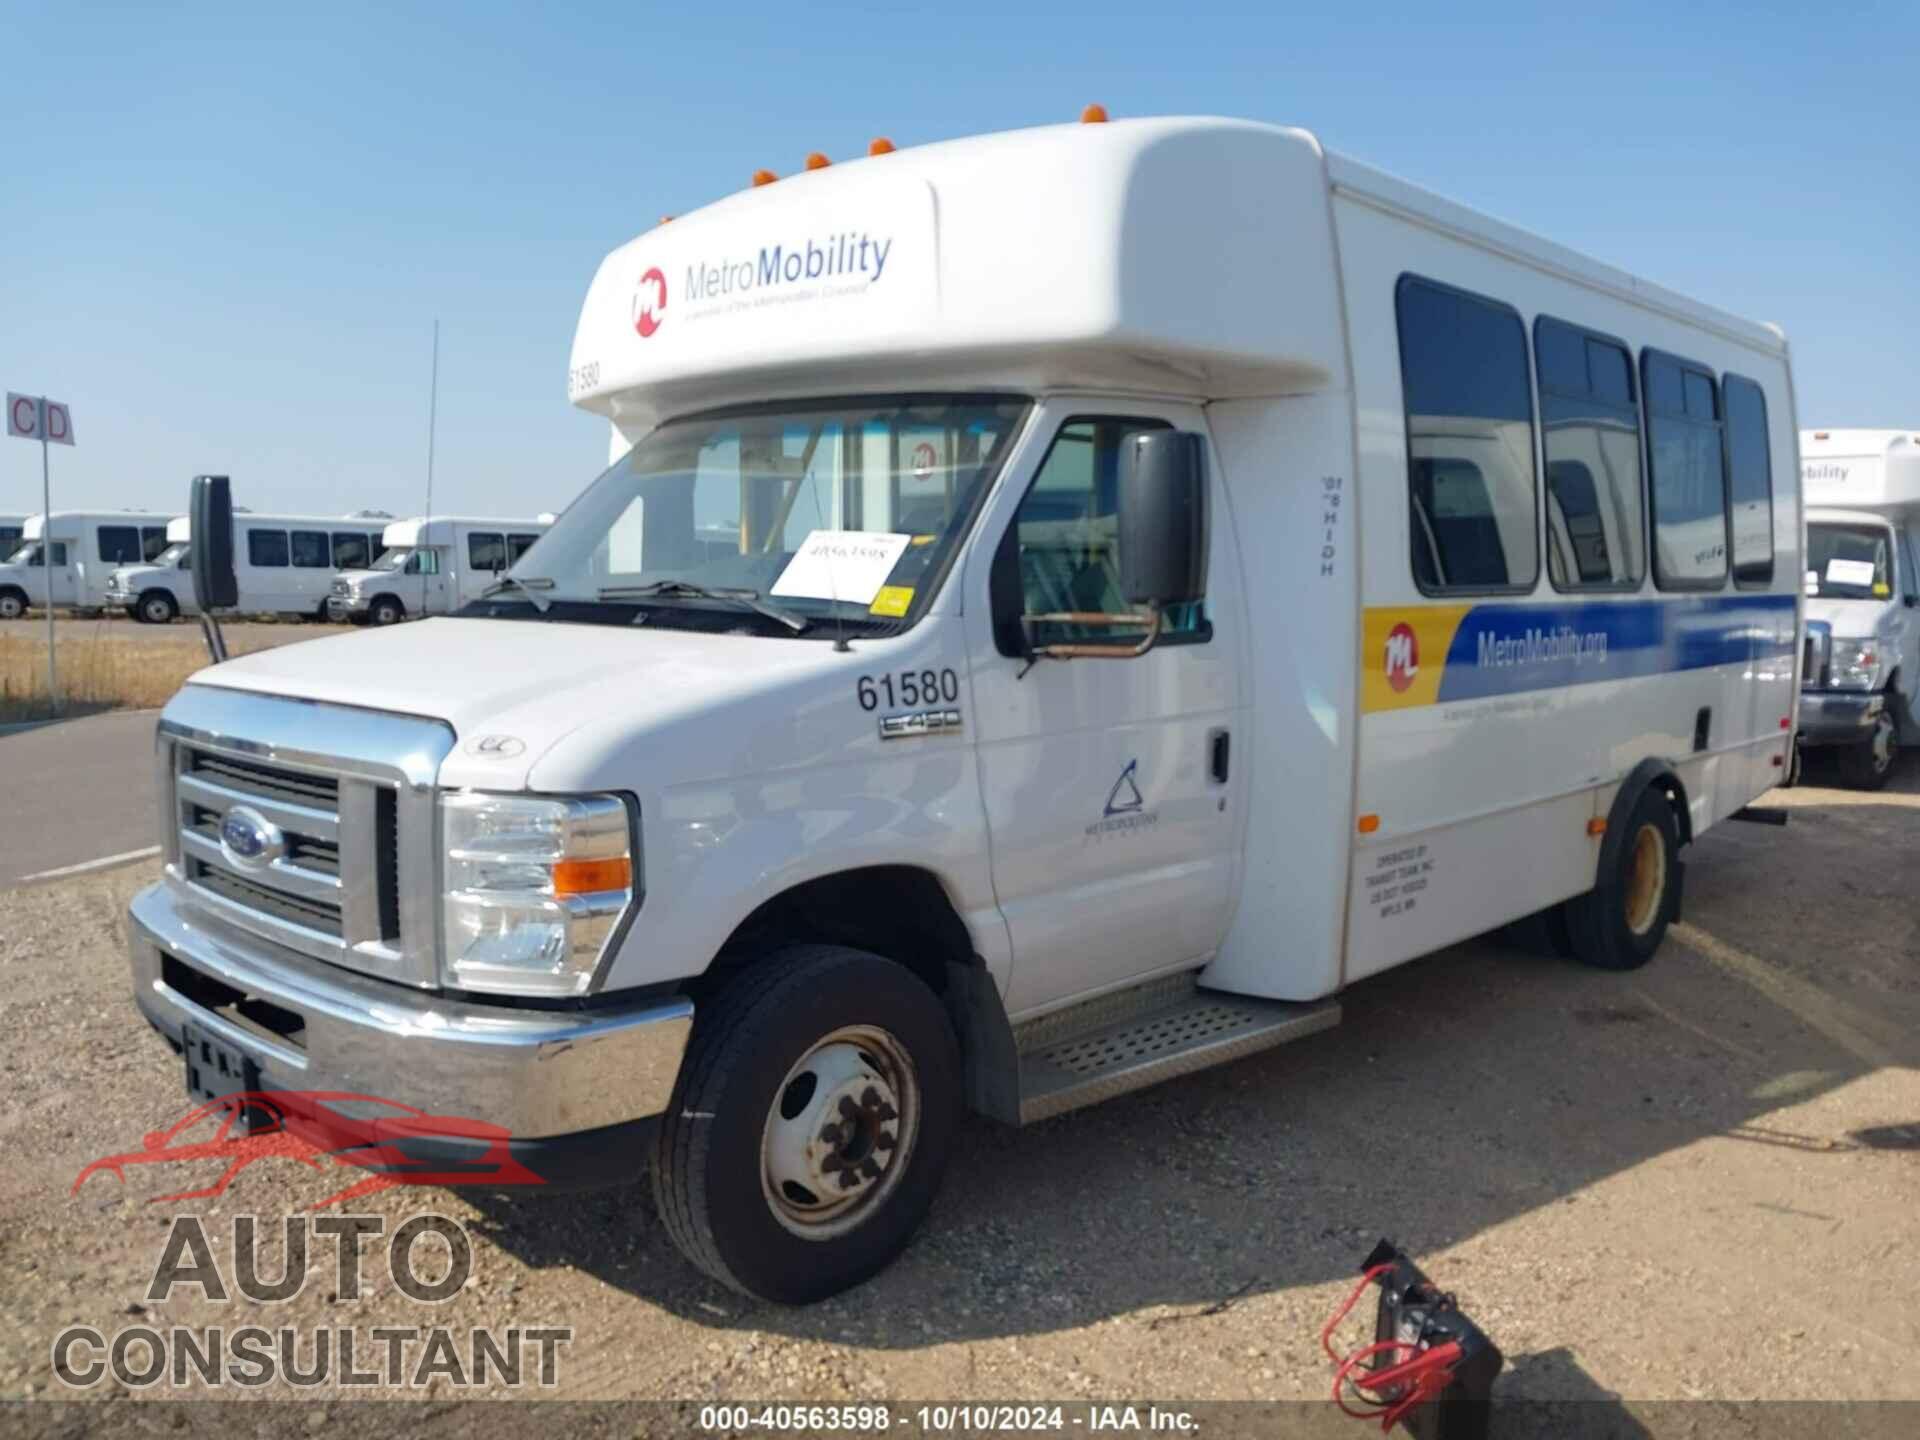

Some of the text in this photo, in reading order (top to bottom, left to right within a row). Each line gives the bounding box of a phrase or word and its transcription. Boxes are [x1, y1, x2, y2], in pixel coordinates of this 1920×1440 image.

[684, 231, 893, 303] MetroMobility
[13, 397, 35, 434] C
[47, 404, 68, 439] D
[1478, 626, 1608, 669] MetroMobility.org
[857, 668, 958, 711] 61580
